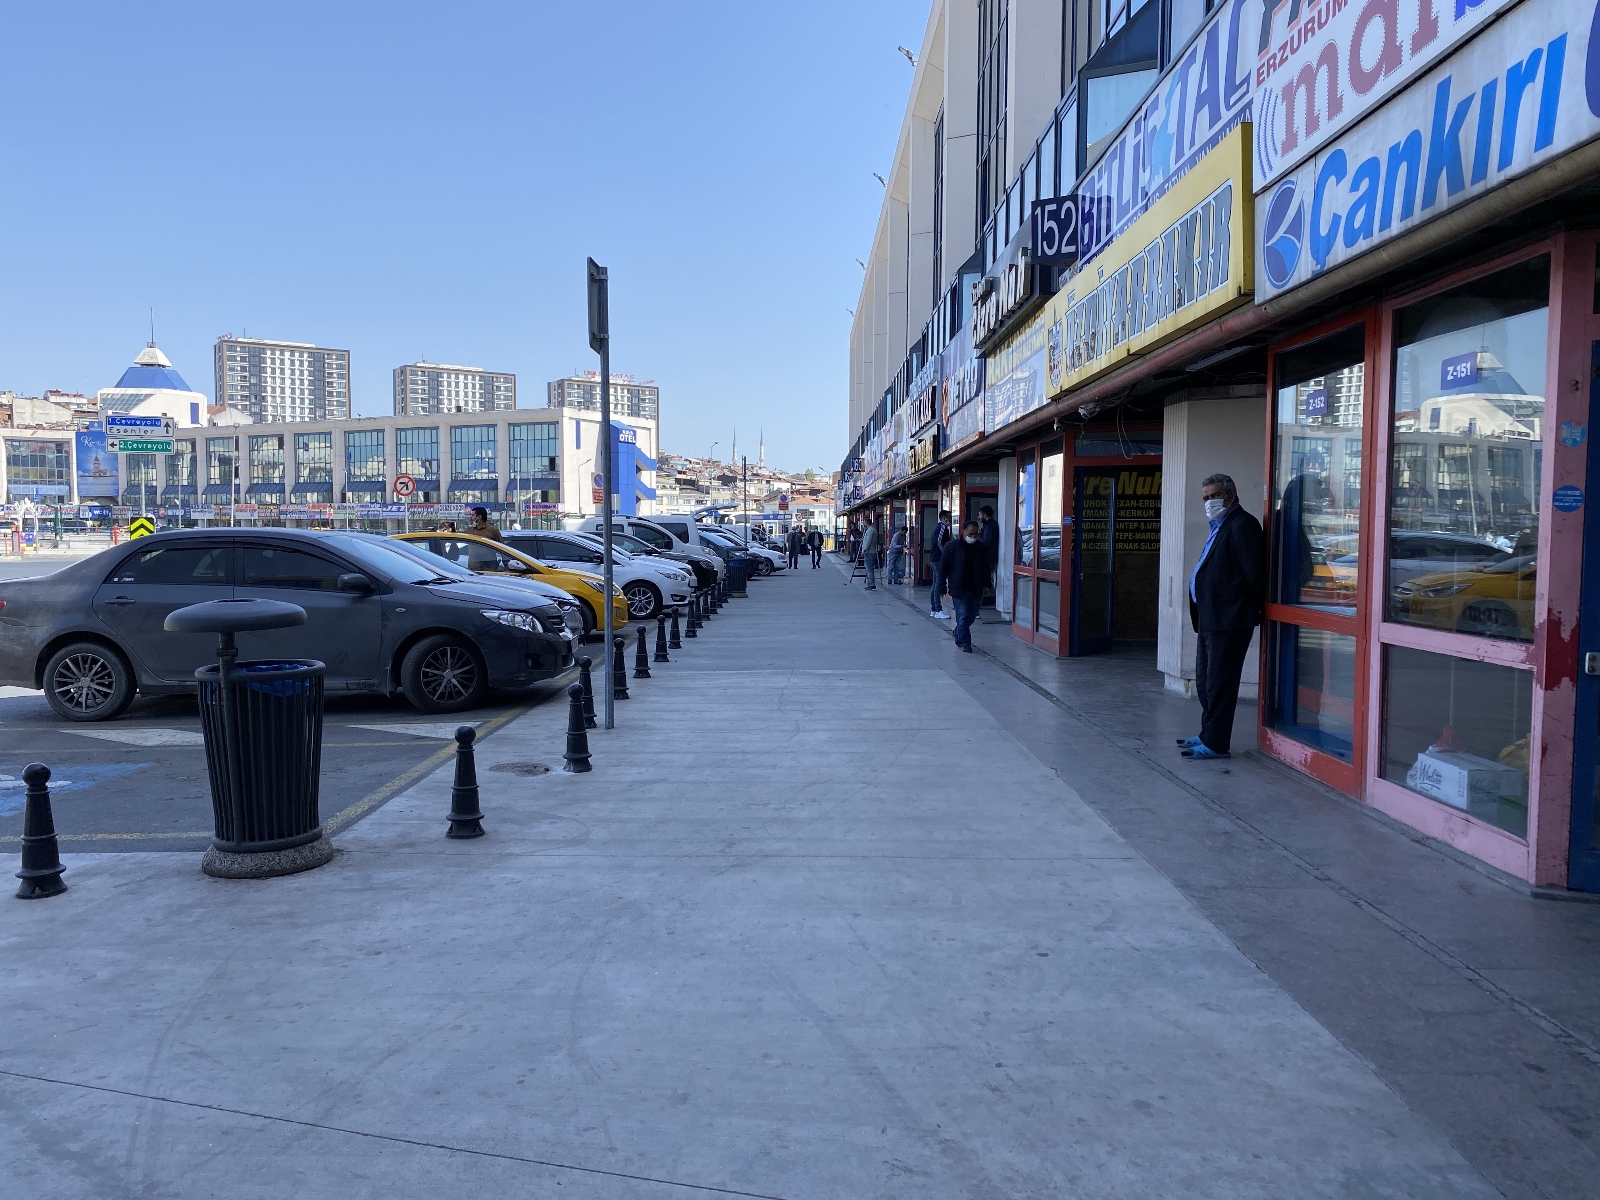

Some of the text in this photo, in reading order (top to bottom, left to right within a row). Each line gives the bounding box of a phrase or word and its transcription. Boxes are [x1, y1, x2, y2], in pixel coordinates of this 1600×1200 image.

[1310, 31, 1568, 275] Çankırı
[1034, 201, 1077, 257] 152
[1446, 362, 1472, 381] Z-151
[1308, 396, 1326, 411] Z-152
[108, 418, 161, 426] 1.Çevreyolu
[109, 426, 156, 434] Esenler
[619, 433, 637, 443] OTEL
[119, 440, 172, 450] 2.Çevreyolu
